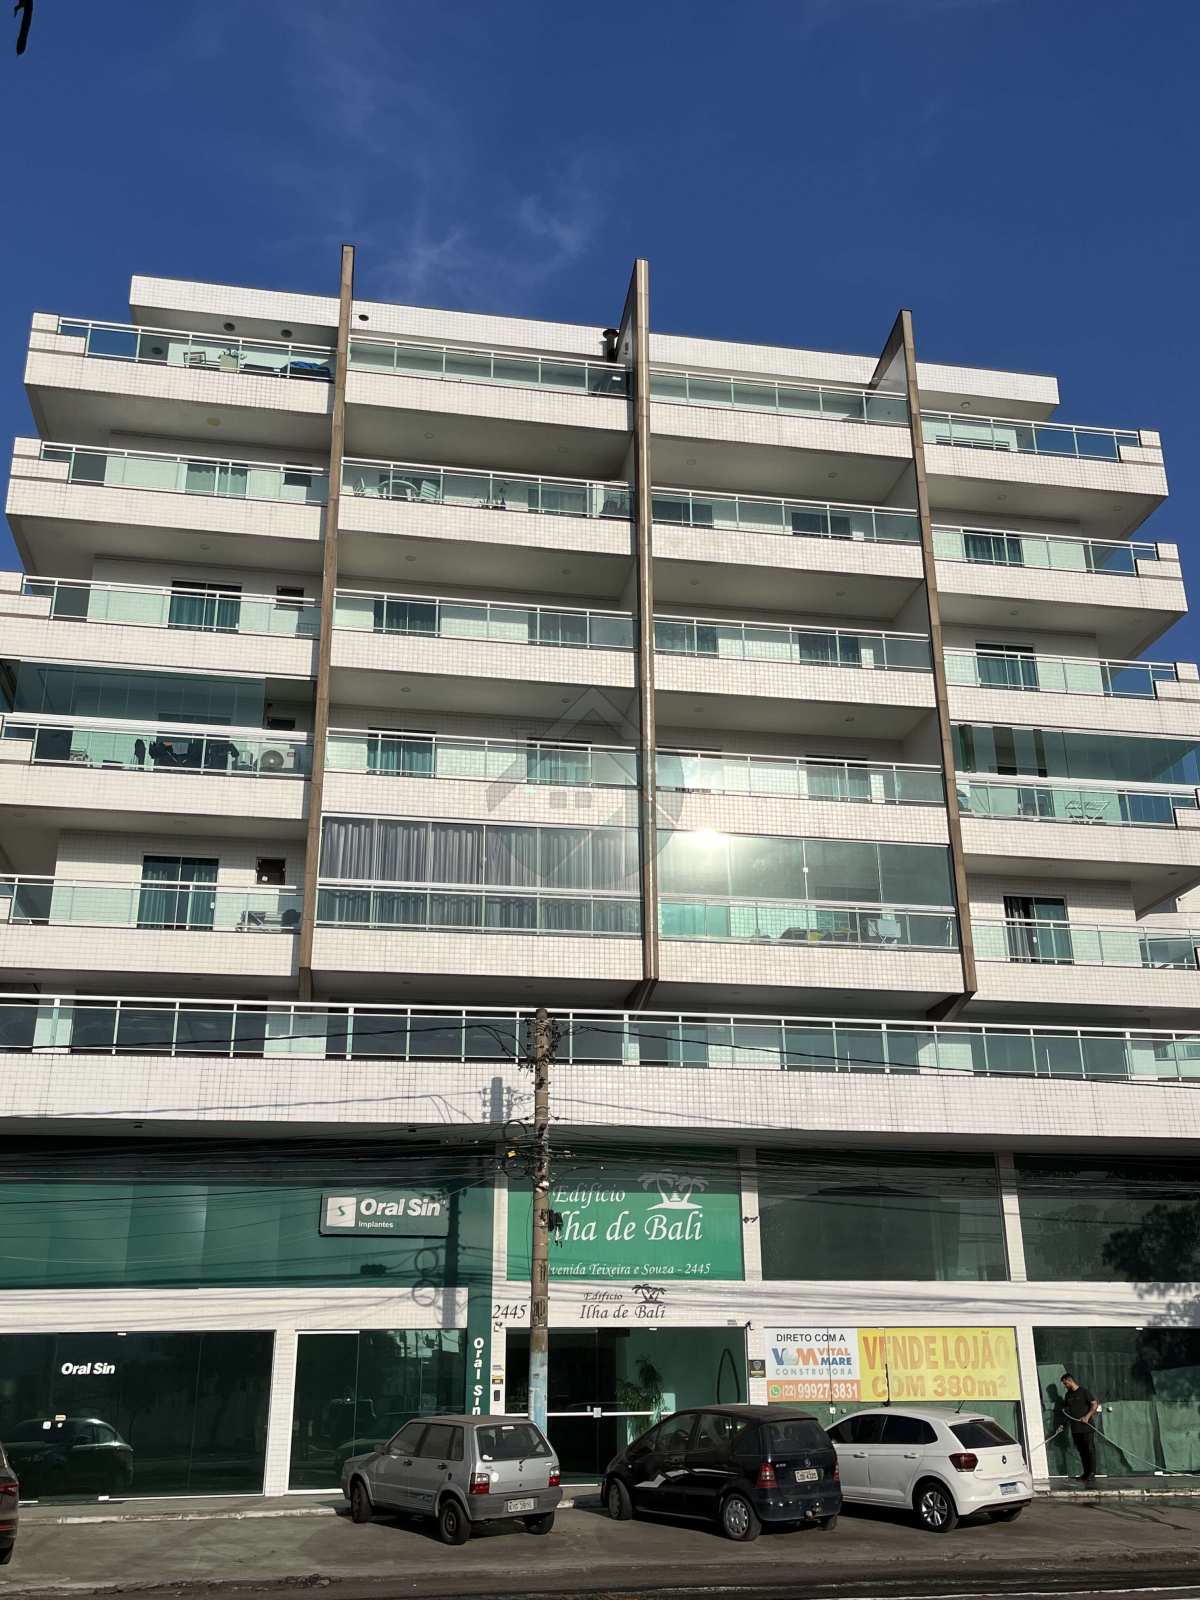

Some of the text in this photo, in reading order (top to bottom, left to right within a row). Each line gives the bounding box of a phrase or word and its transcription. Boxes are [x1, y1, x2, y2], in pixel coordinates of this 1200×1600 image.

[360, 1198, 441, 1216] Oral Sin
[358, 1220, 394, 1229] Implantes
[548, 1210, 703, 1241] lha de Bali
[547, 1262, 586, 1275] venida
[589, 1263, 631, 1277] Teixeira
[633, 1266, 640, 1275] e
[641, 1264, 674, 1275] Souza
[685, 1263, 711, 1275] 2445
[492, 1304, 528, 1320] 2445
[580, 1304, 666, 1319] Ilha de Bali
[776, 1333, 846, 1342] DIRETO COM A
[817, 1347, 851, 1356] VITAL
[862, 1330, 1011, 1371] VENDE LOJÃO
[61, 1362, 116, 1375] Oral Sin
[820, 1357, 852, 1366] MARE
[472, 1337, 485, 1416] Oral Sin
[775, 1368, 852, 1376] CONSTRUTORA
[871, 1375, 926, 1398] COM
